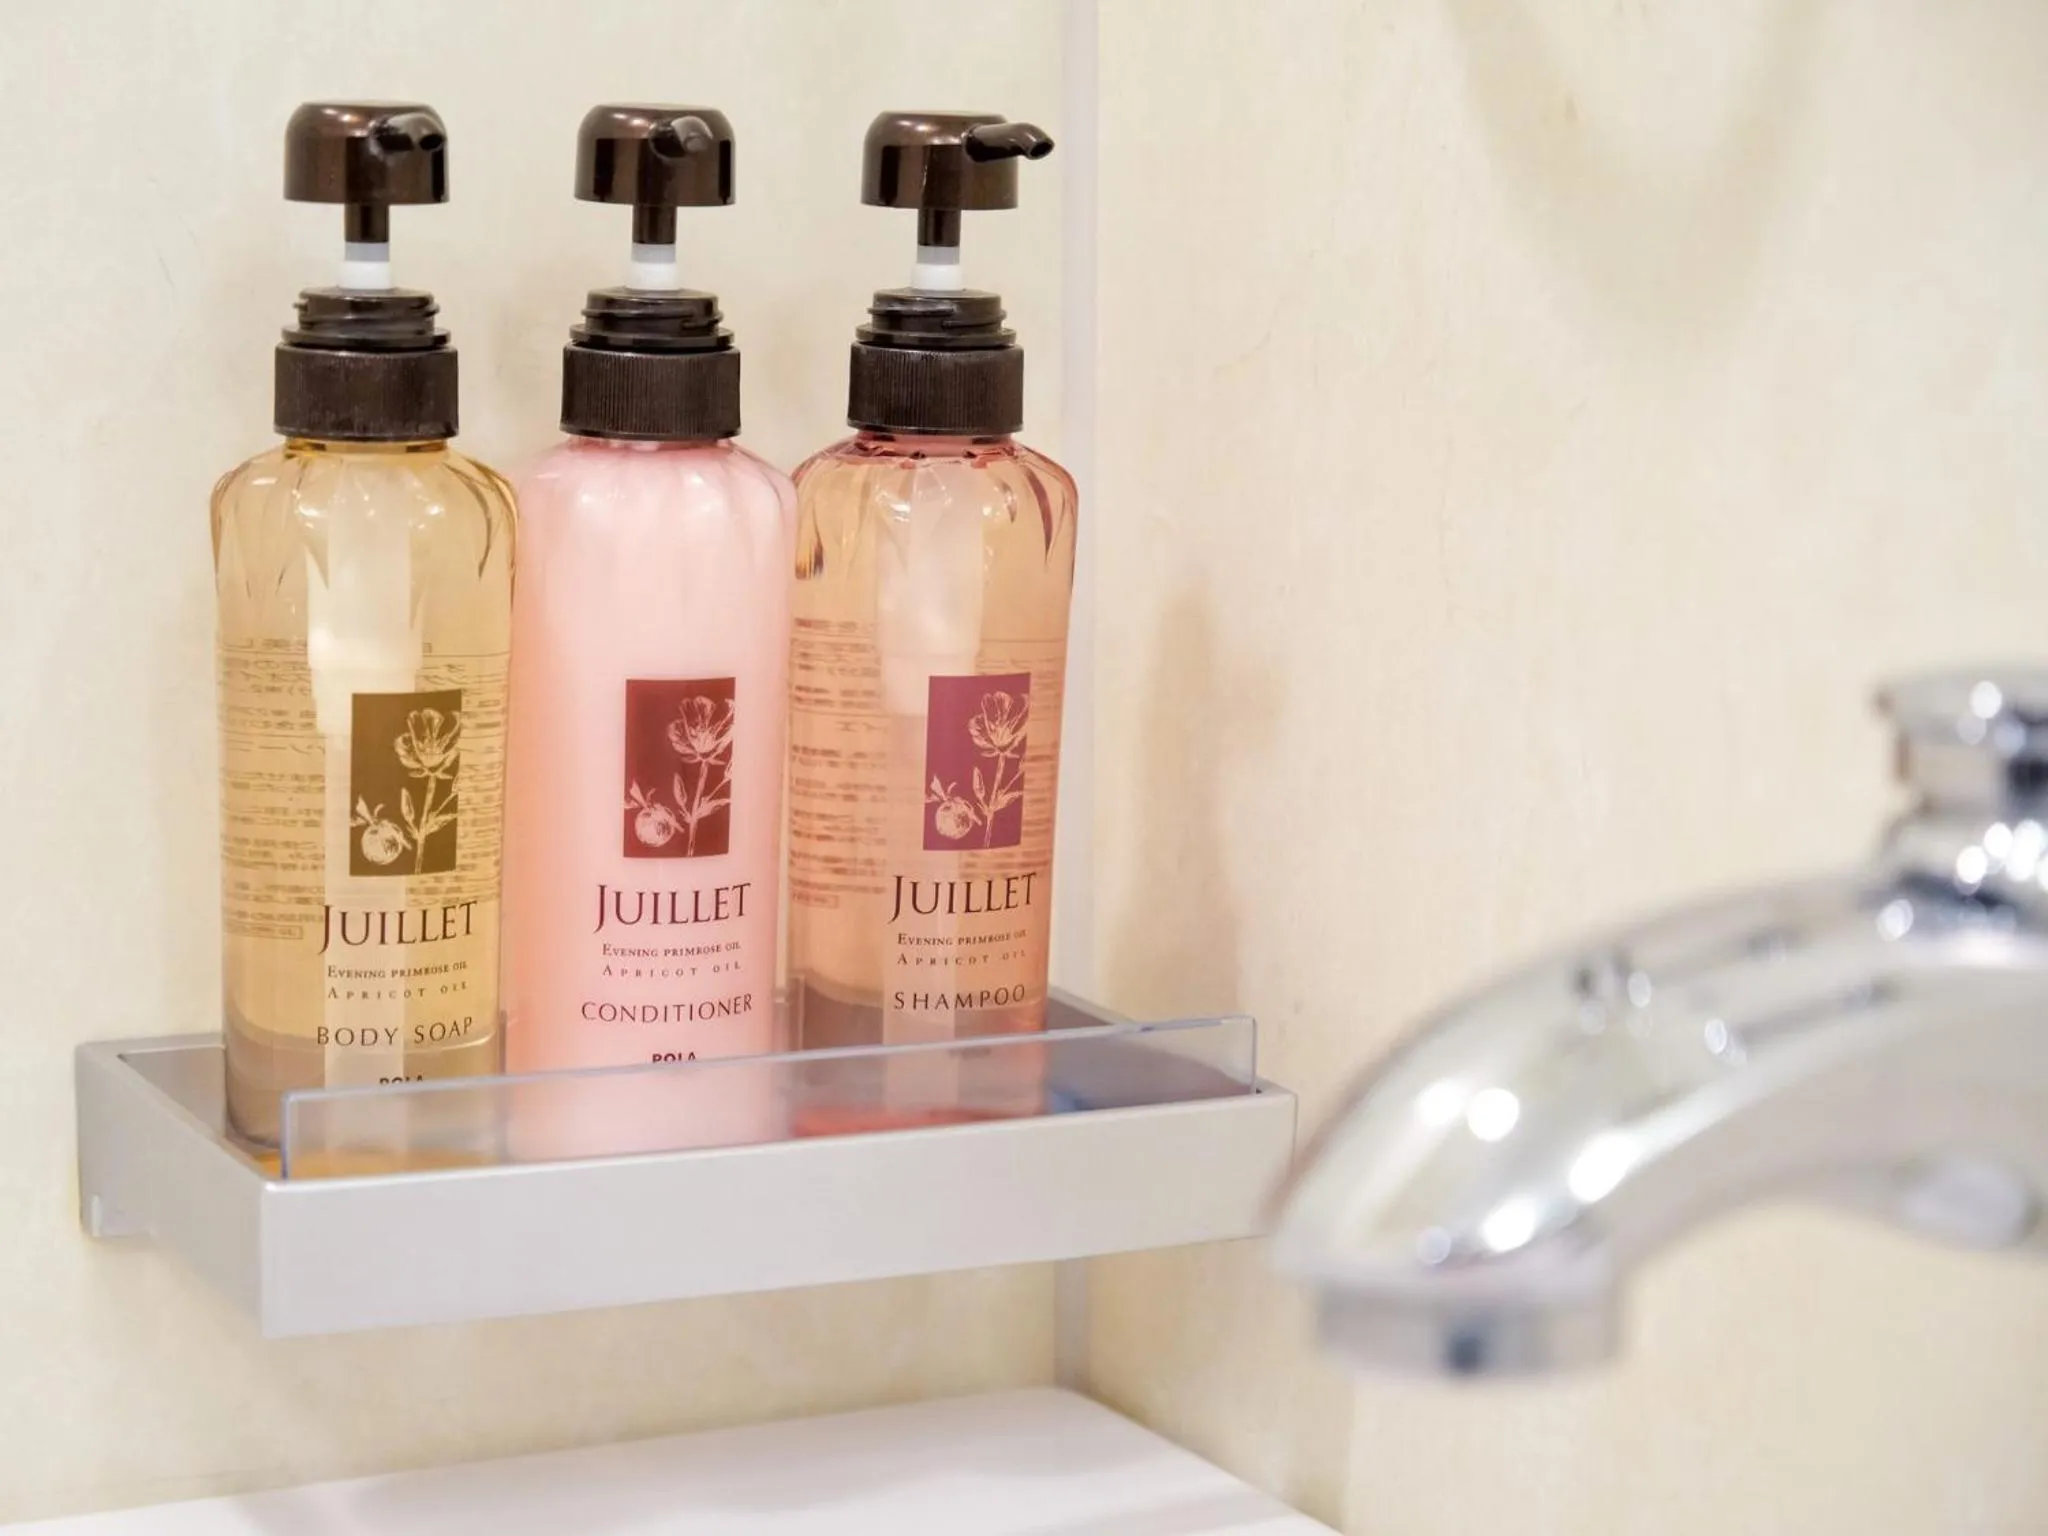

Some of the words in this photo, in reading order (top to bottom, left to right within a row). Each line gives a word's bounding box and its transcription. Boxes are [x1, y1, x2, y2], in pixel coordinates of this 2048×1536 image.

[592, 882, 751, 934] JUILLET
[887, 871, 1036, 925] JUILLET
[318, 900, 477, 955] JUILLET
[581, 993, 752, 1023] CONDITIONER
[894, 984, 1025, 1010] SHAMPOO
[317, 1026, 398, 1046] BODY
[413, 1016, 473, 1045] SOAP
